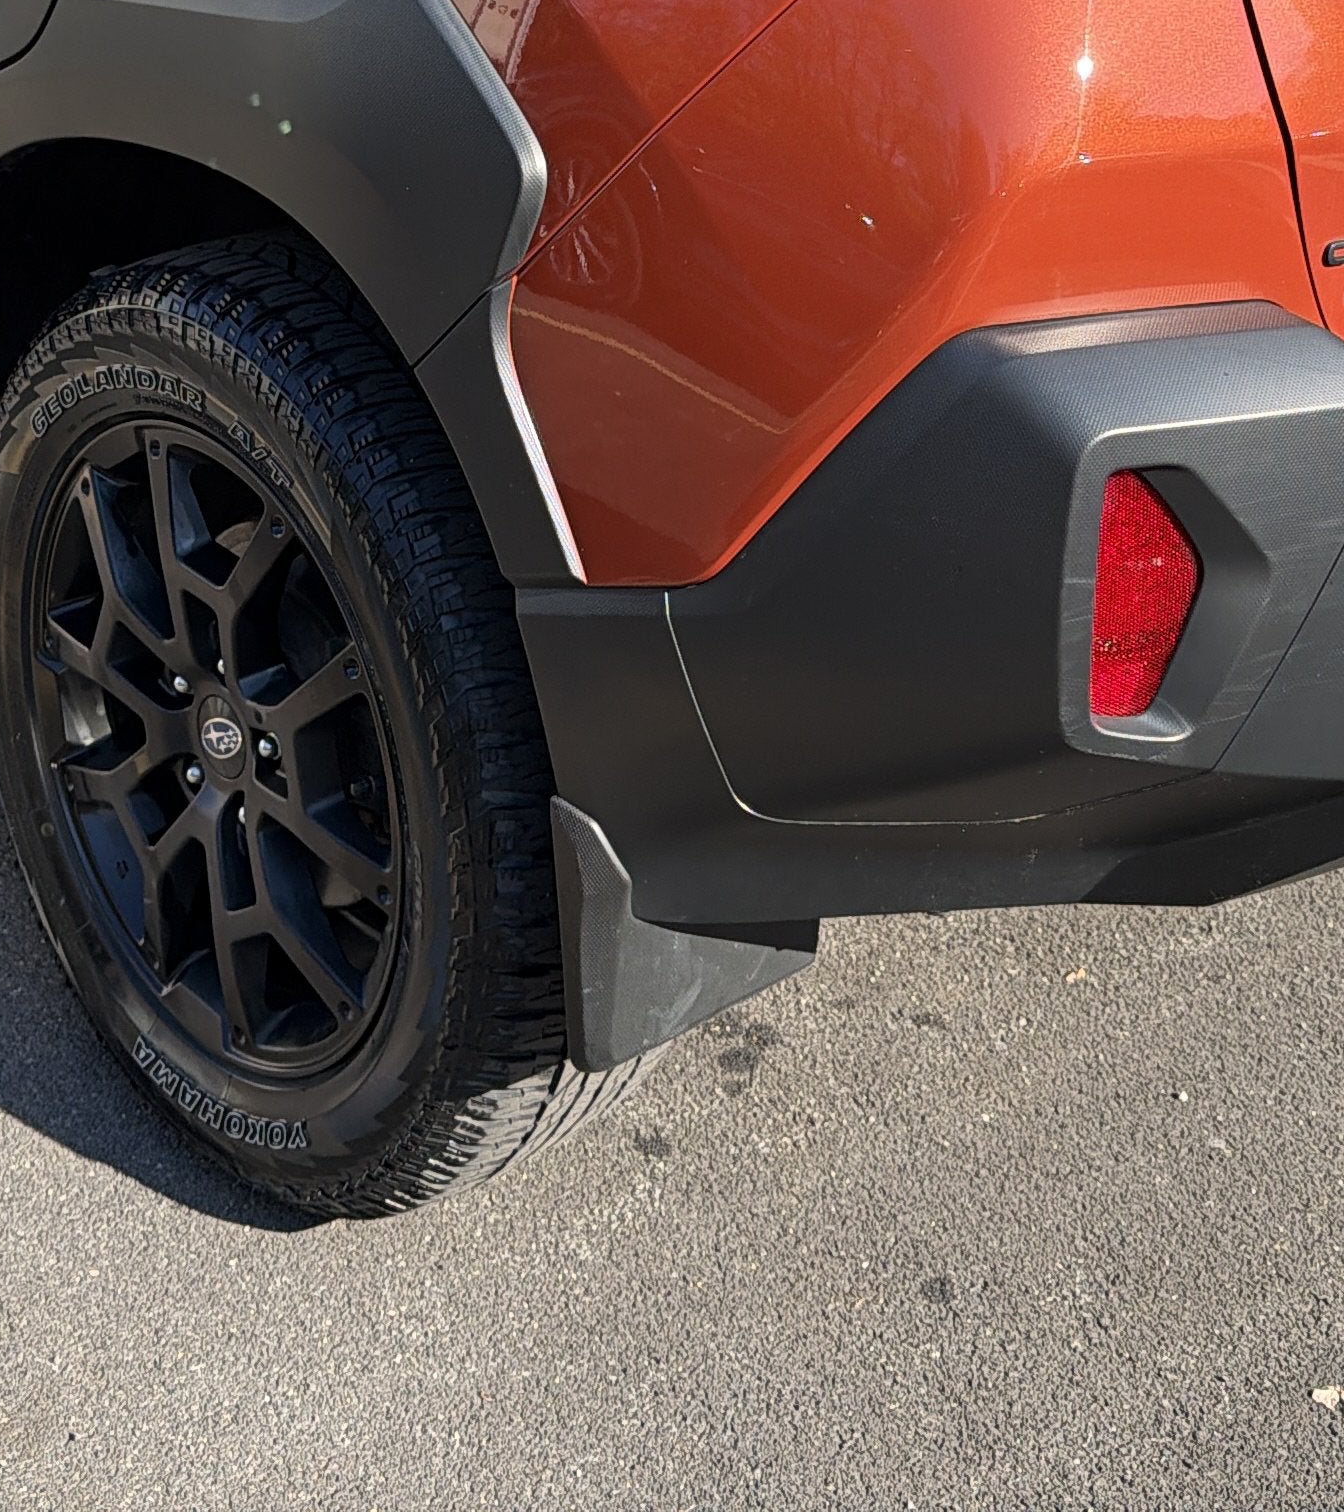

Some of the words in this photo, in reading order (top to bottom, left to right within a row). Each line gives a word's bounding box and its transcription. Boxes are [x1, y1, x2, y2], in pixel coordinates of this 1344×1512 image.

[30, 363, 207, 438] GEOLANDAR
[227, 418, 295, 489] A/T
[132, 1034, 309, 1151] YOKOHAMA
